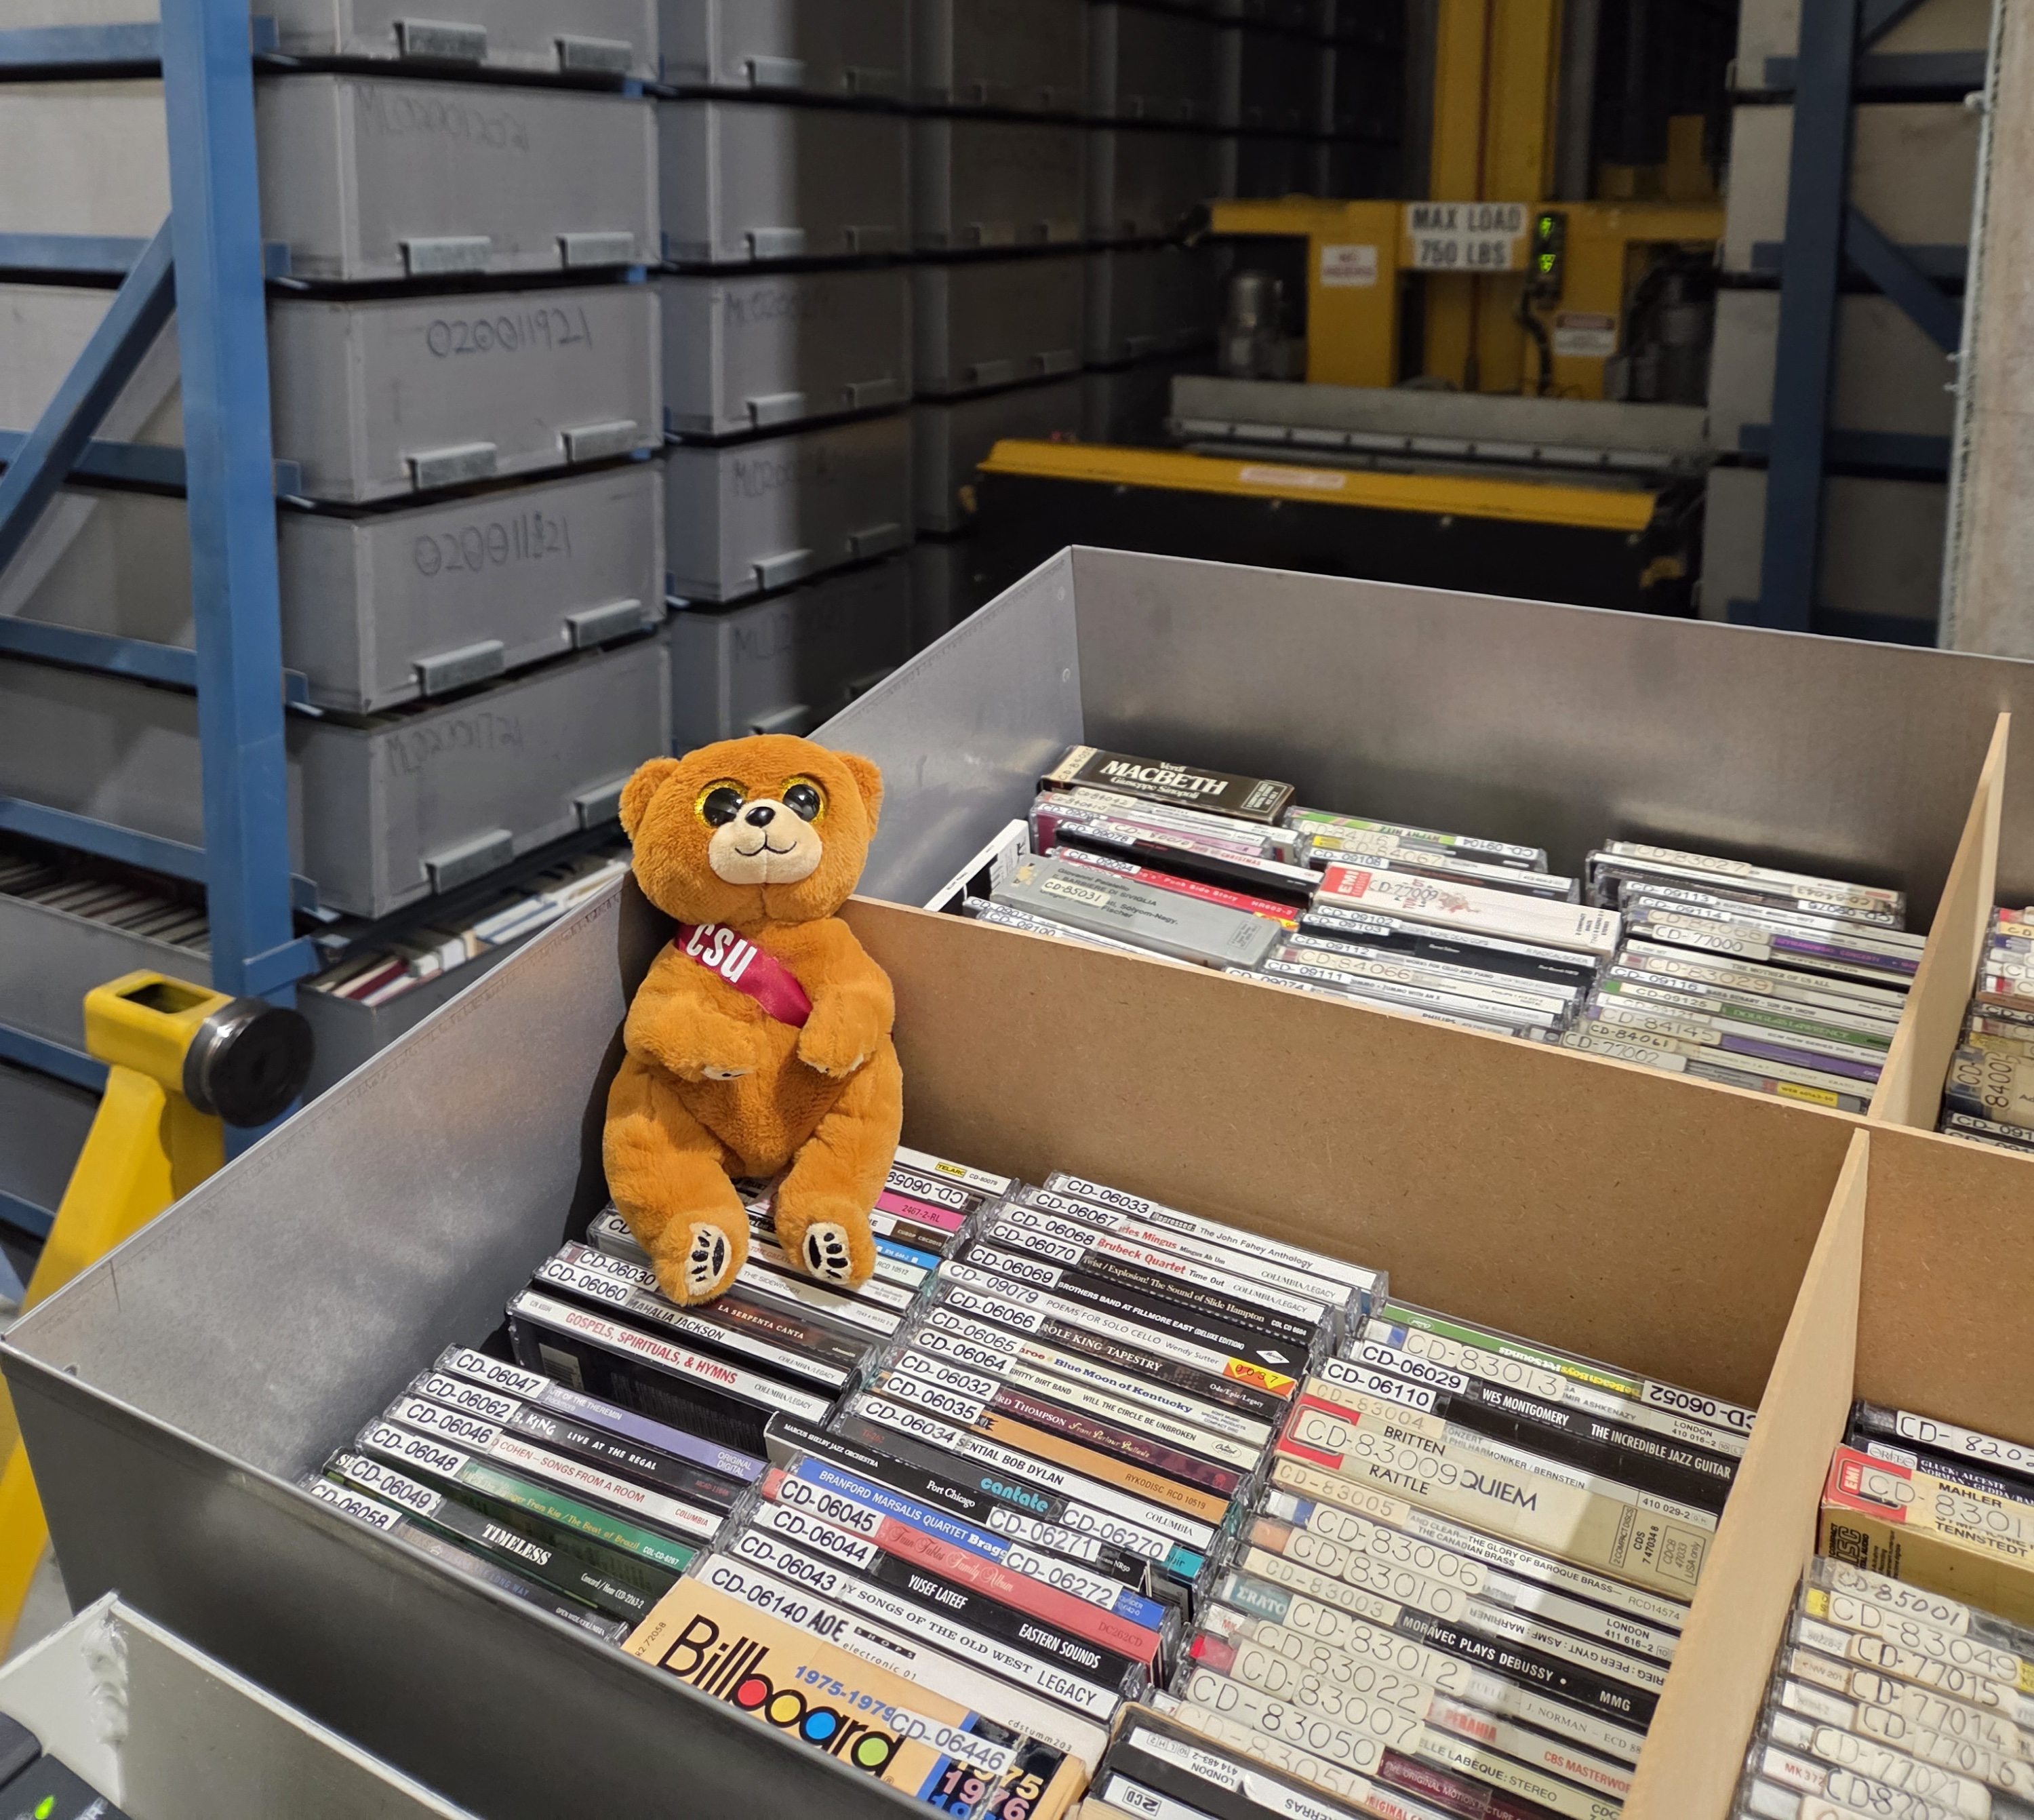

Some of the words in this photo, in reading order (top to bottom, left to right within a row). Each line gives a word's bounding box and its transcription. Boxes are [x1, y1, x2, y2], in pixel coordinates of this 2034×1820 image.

[1412, 207, 1458, 230] MAX
[1467, 207, 1523, 231] LOAD
[1424, 239, 1458, 264] 750
[1467, 240, 1506, 264] LBS
[1100, 760, 1229, 795] MACBETH
[1159, 761, 1186, 772] Verdi
[1111, 776, 1157, 791] Giuseppe
[1156, 780, 1200, 799] Sinopoli
[1044, 881, 1102, 903] CD-85031
[1058, 867, 1091, 882] Giovanni
[1337, 869, 1361, 894] EMI
[1102, 905, 1134, 919] Fischer
[1119, 890, 1157, 906] SIVIGLIA
[686, 923, 758, 983] CSU
[1731, 963, 1748, 974] THE
[1813, 976, 1830, 988] ALL
[1591, 1024, 1669, 1048] CD-84061
[937, 1163, 965, 1177] TELARC
[902, 1205, 941, 1223] 2467-2-RL
[1036, 1194, 1119, 1227] CD-06067
[1142, 1231, 1178, 1250] Mingus
[1260, 1270, 1336, 1299] COLUMBIA/LEGACY
[1216, 1231, 1238, 1244] John
[1239, 1239, 1267, 1256] Fahey
[1267, 1249, 1314, 1270] Anthology
[579, 1251, 656, 1286] CD-06030
[877, 1261, 890, 1271] RCD
[993, 1225, 1076, 1261] CD-06070
[1150, 1278, 1165, 1290] The
[1166, 1282, 1193, 1299] Sound
[1205, 1294, 1224, 1309] Slide
[1226, 1303, 1265, 1324] Hampton
[1097, 1238, 1140, 1261] Brubeck
[1144, 1254, 1186, 1275] Quartet
[1188, 1269, 1208, 1282] Time
[1210, 1275, 1224, 1287] Out
[1233, 1284, 1308, 1313] COLUMBIA/LEGACY
[757, 1273, 801, 1295] SIDEWINDER
[970, 1249, 1054, 1284] CD-06069
[1058, 1282, 1099, 1303] BROTHERS
[1099, 1295, 1121, 1309] BAND
[1132, 1305, 1171, 1326] FILLMORE
[1171, 1320, 1195, 1332] EAST
[674, 1316, 725, 1341] JACKSON
[732, 1309, 774, 1329] SERPENTA
[776, 1324, 804, 1339] CANTA
[949, 1291, 1035, 1328] CD-06066
[1072, 1334, 1102, 1351] KING
[1105, 1345, 1163, 1372] TAPESTRY
[1045, 1299, 1080, 1317] POEMS
[1101, 1318, 1129, 1334] SOLO
[1130, 1328, 1161, 1345] CELLO
[1165, 1340, 1193, 1358] Wendy
[1194, 1351, 1219, 1366] Sutter
[565, 1311, 614, 1341] GOSPELS,
[616, 1330, 682, 1366] SPIRITUALS,
[695, 1360, 738, 1385] HYMNS
[932, 1312, 1017, 1354] CD-06065
[1083, 1368, 1117, 1387] Moon
[456, 1353, 540, 1393] CD-06047
[425, 1378, 511, 1419] CD-06062
[526, 1413, 557, 1436] KING
[567, 1431, 589, 1445] LIVE
[628, 1453, 658, 1471] REGAL
[1014, 1398, 1068, 1427] THOMPSON
[1051, 1381, 1072, 1396] BAND
[1082, 1394, 1099, 1406] WILL
[1116, 1406, 1144, 1421] CIRCLE
[1155, 1419, 1197, 1441] UNBROKEN
[1363, 1346, 1461, 1389] CD-06029
[1483, 1388, 1501, 1403] WES
[1502, 1394, 1570, 1426] MONTGOMERY
[1610, 1430, 1667, 1459] INCREDIBLE
[1667, 1449, 1693, 1467] JAZZ
[1694, 1457, 1732, 1480] GUITAR
[405, 1403, 493, 1444] CD-06046
[499, 1440, 532, 1460] COHEN
[540, 1455, 576, 1477] SONGS
[574, 1469, 605, 1488] FROM
[613, 1484, 645, 1503] ROOM
[865, 1402, 957, 1444] CD-06034
[1002, 1455, 1025, 1469] BOB
[1026, 1465, 1065, 1486] DYLAN
[1305, 1419, 1458, 1486] CD-83009
[1383, 1425, 1446, 1457] BRITTEN
[716, 1459, 744, 1477] DIGITAL
[717, 1450, 752, 1471] ORIGINAL
[783, 1423, 808, 1439] MARCUS
[829, 1441, 845, 1454] JAZZ
[926, 1480, 944, 1495] Port
[944, 1487, 976, 1508] Chicago
[1533, 1465, 1585, 1489] BERNSTEIN
[1843, 1465, 1860, 1490] EMI
[1125, 1472, 1165, 1495] RYKODISC
[1184, 1494, 1207, 1510] 10519
[1368, 1464, 1431, 1496] RATTLE
[1938, 1482, 2002, 1509] MAHLER
[1961, 1471, 2007, 1491] ALCESTE
[351, 1459, 433, 1508] CD-06049
[481, 1523, 553, 1566] TIMELESS
[819, 1470, 871, 1499] BRANFORD
[871, 1492, 921, 1520] MARSALIS
[923, 1514, 969, 1541] QUARTET
[980, 1477, 1048, 1513] cantate
[1062, 1510, 1164, 1558] CD-06270
[1633, 1530, 1646, 1551] CDS
[1663, 1539, 1677, 1565] CDCB
[1676, 1543, 1688, 1569] 47033
[1935, 1522, 2029, 1558] TENNSTEDT
[1486, 1541, 1519, 1558] GLORY
[1533, 1558, 1580, 1583] BAROQUE
[711, 1568, 809, 1623] CD-06140
[773, 1511, 870, 1562] CD-06044
[907, 1574, 936, 1596] YUSEF
[936, 1585, 969, 1610] LATEEF
[1018, 1623, 1059, 1653] EASTERN
[1059, 1640, 1102, 1669] SOUNDS
[740, 1535, 838, 1592] CD-06043
[857, 1590, 904, 1617] SONGS
[959, 1636, 989, 1655] OLD
[991, 1649, 1033, 1674] WEST
[1037, 1671, 1098, 1707] LEGACY
[1098, 1621, 1142, 1648] DC262CD
[1831, 1596, 2018, 1682] CD-83049
[842, 1641, 900, 1675] electronic
[1402, 1615, 1458, 1645] MORAVEC
[1459, 1636, 1496, 1661] PLAYS
[1498, 1651, 1555, 1682] DEBUSSY
[1599, 1690, 1632, 1712] MMG
[656, 1613, 906, 1778] Billboard
[794, 1665, 896, 1723] 1975-1979
[1193, 1675, 1376, 1766] CD-83050
[1538, 1706, 1589, 1733] NORMAN
[1603, 1733, 1627, 1749] ECD
[1543, 1750, 1565, 1768] CBS
[1509, 1775, 1558, 1803] STEREO
